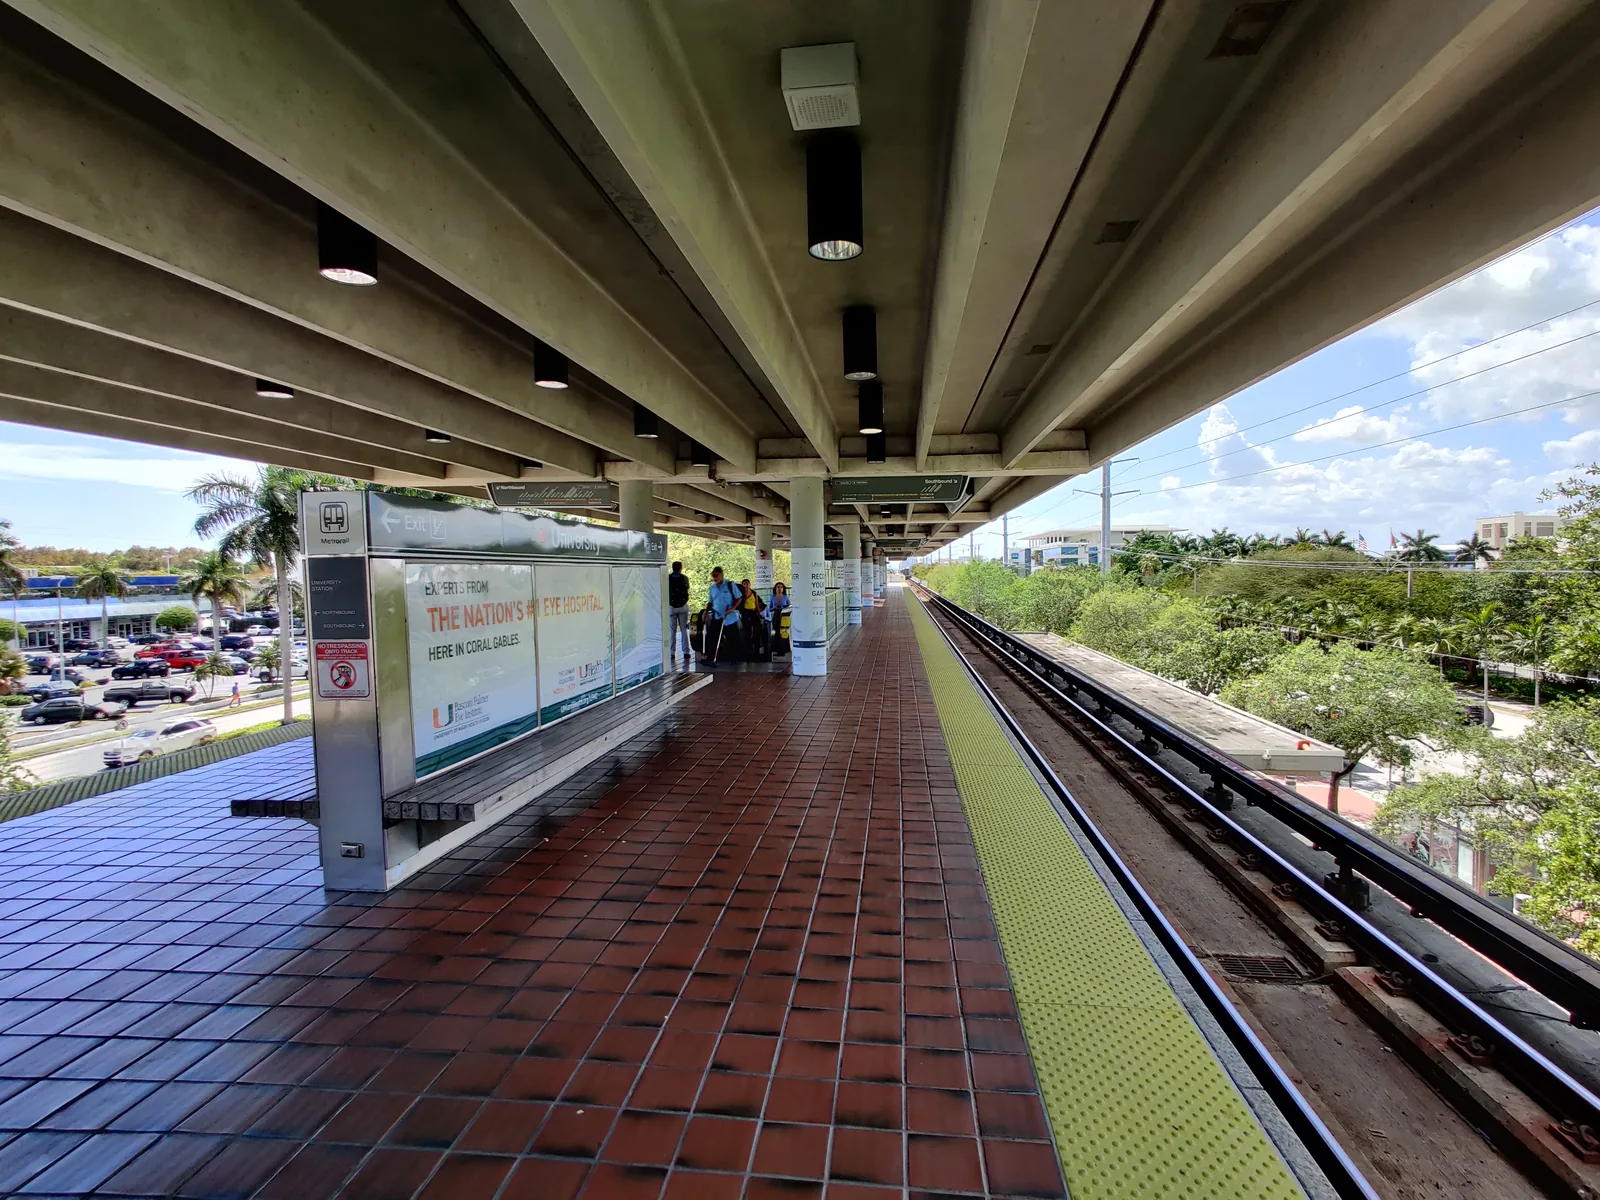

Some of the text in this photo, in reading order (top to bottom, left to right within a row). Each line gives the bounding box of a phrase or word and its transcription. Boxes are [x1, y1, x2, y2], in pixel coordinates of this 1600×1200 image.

[405, 515, 425, 532] Exit
[551, 527, 600, 555] University
[425, 580, 489, 596] EXPERTS FROM
[427, 605, 460, 632] THE
[463, 600, 524, 628] NATION'S
[543, 596, 561, 616] EYE
[428, 633, 521, 661] HERE IN CORAL GABLES.
